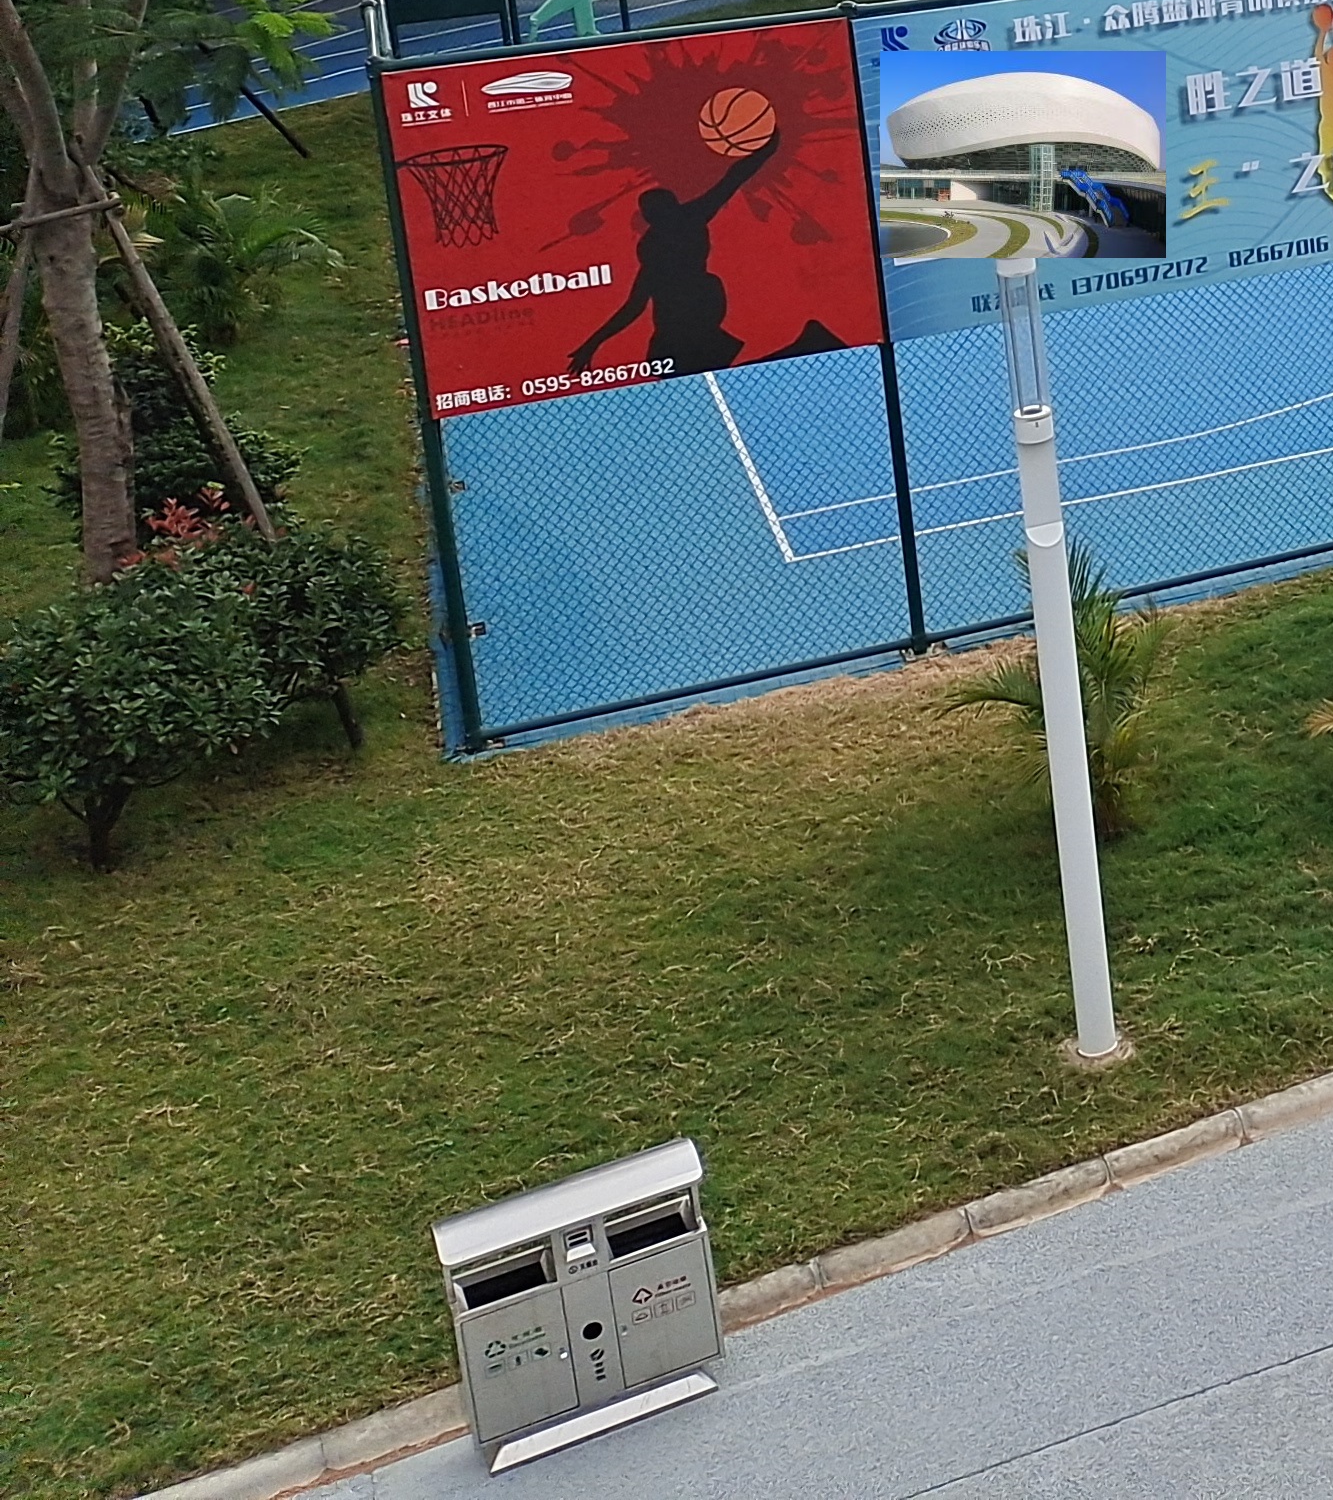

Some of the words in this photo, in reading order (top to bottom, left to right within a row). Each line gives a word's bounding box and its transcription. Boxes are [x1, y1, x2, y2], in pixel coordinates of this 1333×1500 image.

[1186, 57, 1323, 116] 胜之道
[424, 264, 612, 311] Basketball
[1071, 256, 1208, 296] 13706972172
[1228, 235, 1329, 268] 82667016
[522, 358, 675, 396] 0595-82667032
